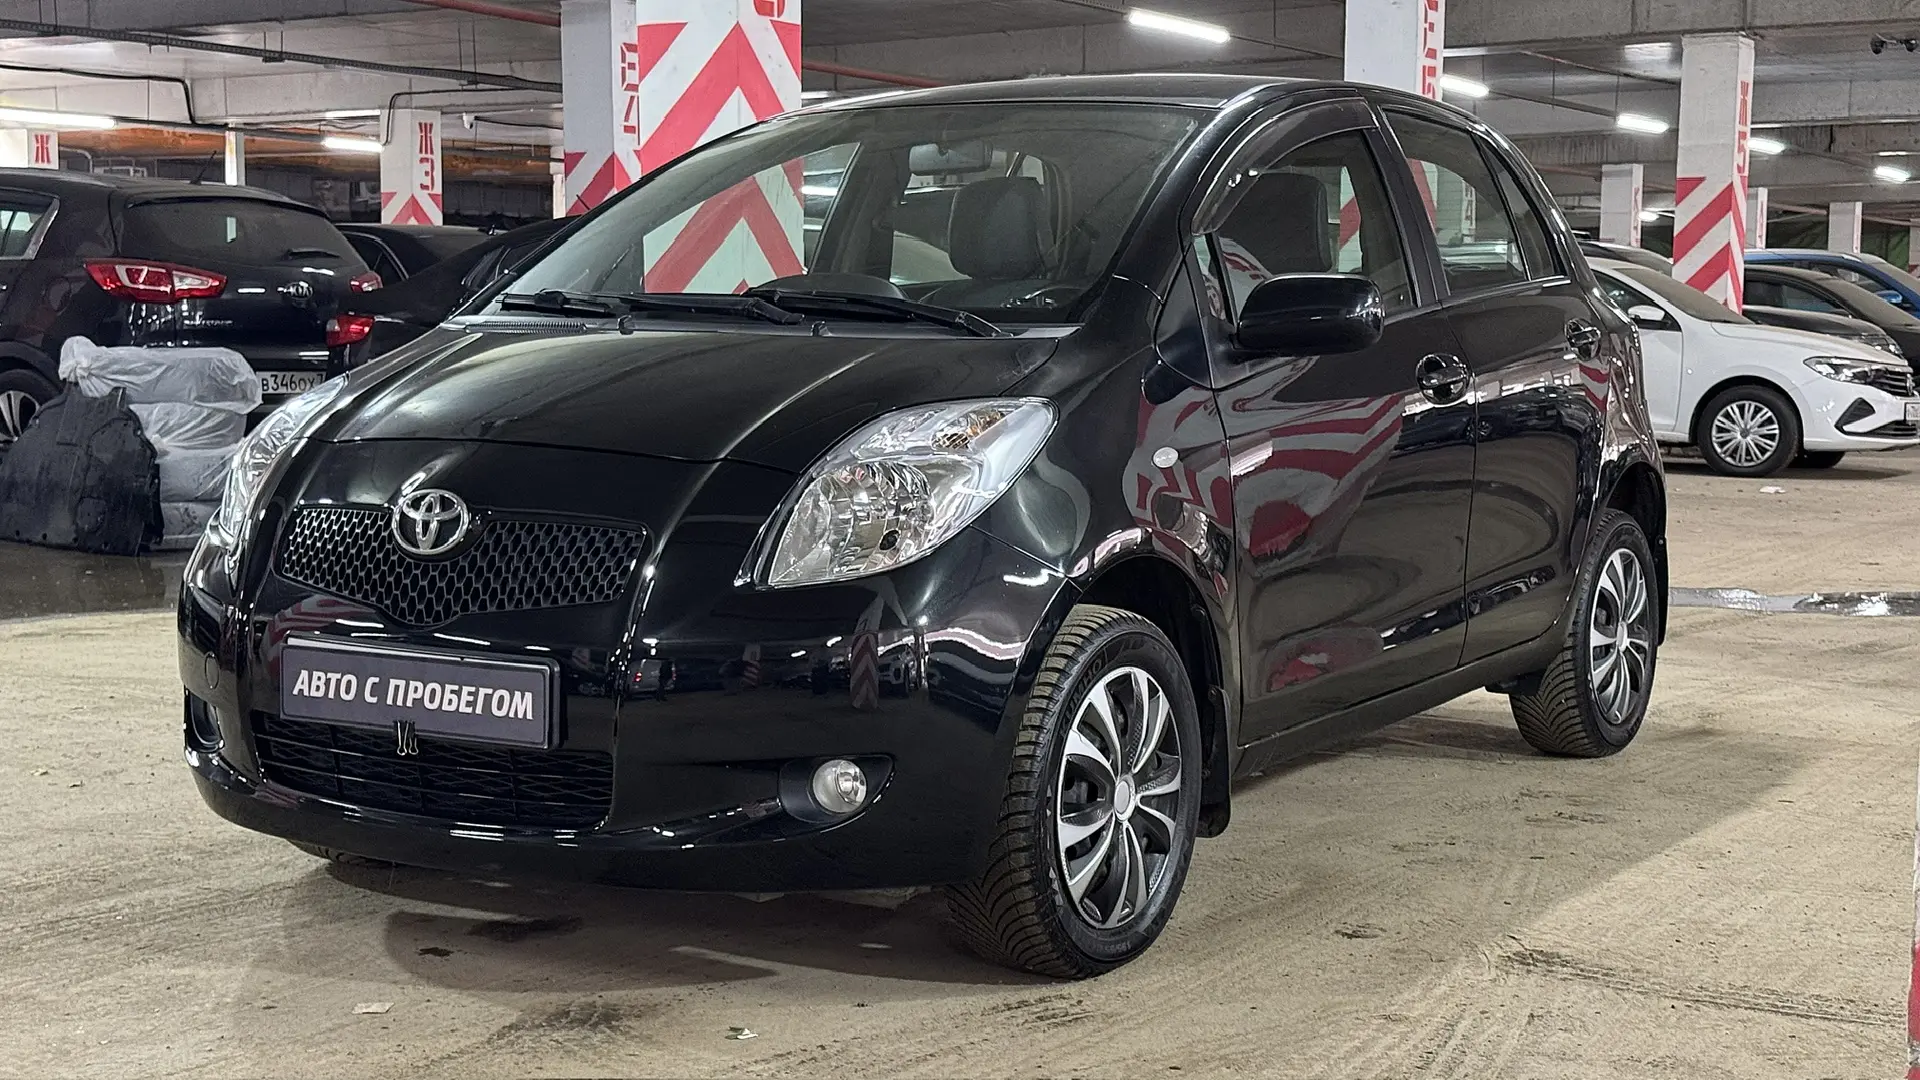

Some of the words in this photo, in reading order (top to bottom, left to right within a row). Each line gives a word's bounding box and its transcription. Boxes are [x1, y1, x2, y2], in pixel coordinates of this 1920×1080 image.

[34, 134, 51, 164] Ж
[293, 669, 358, 701] АВТО
[364, 676, 380, 704] С
[386, 678, 535, 720] ПРОБЕГОМ
